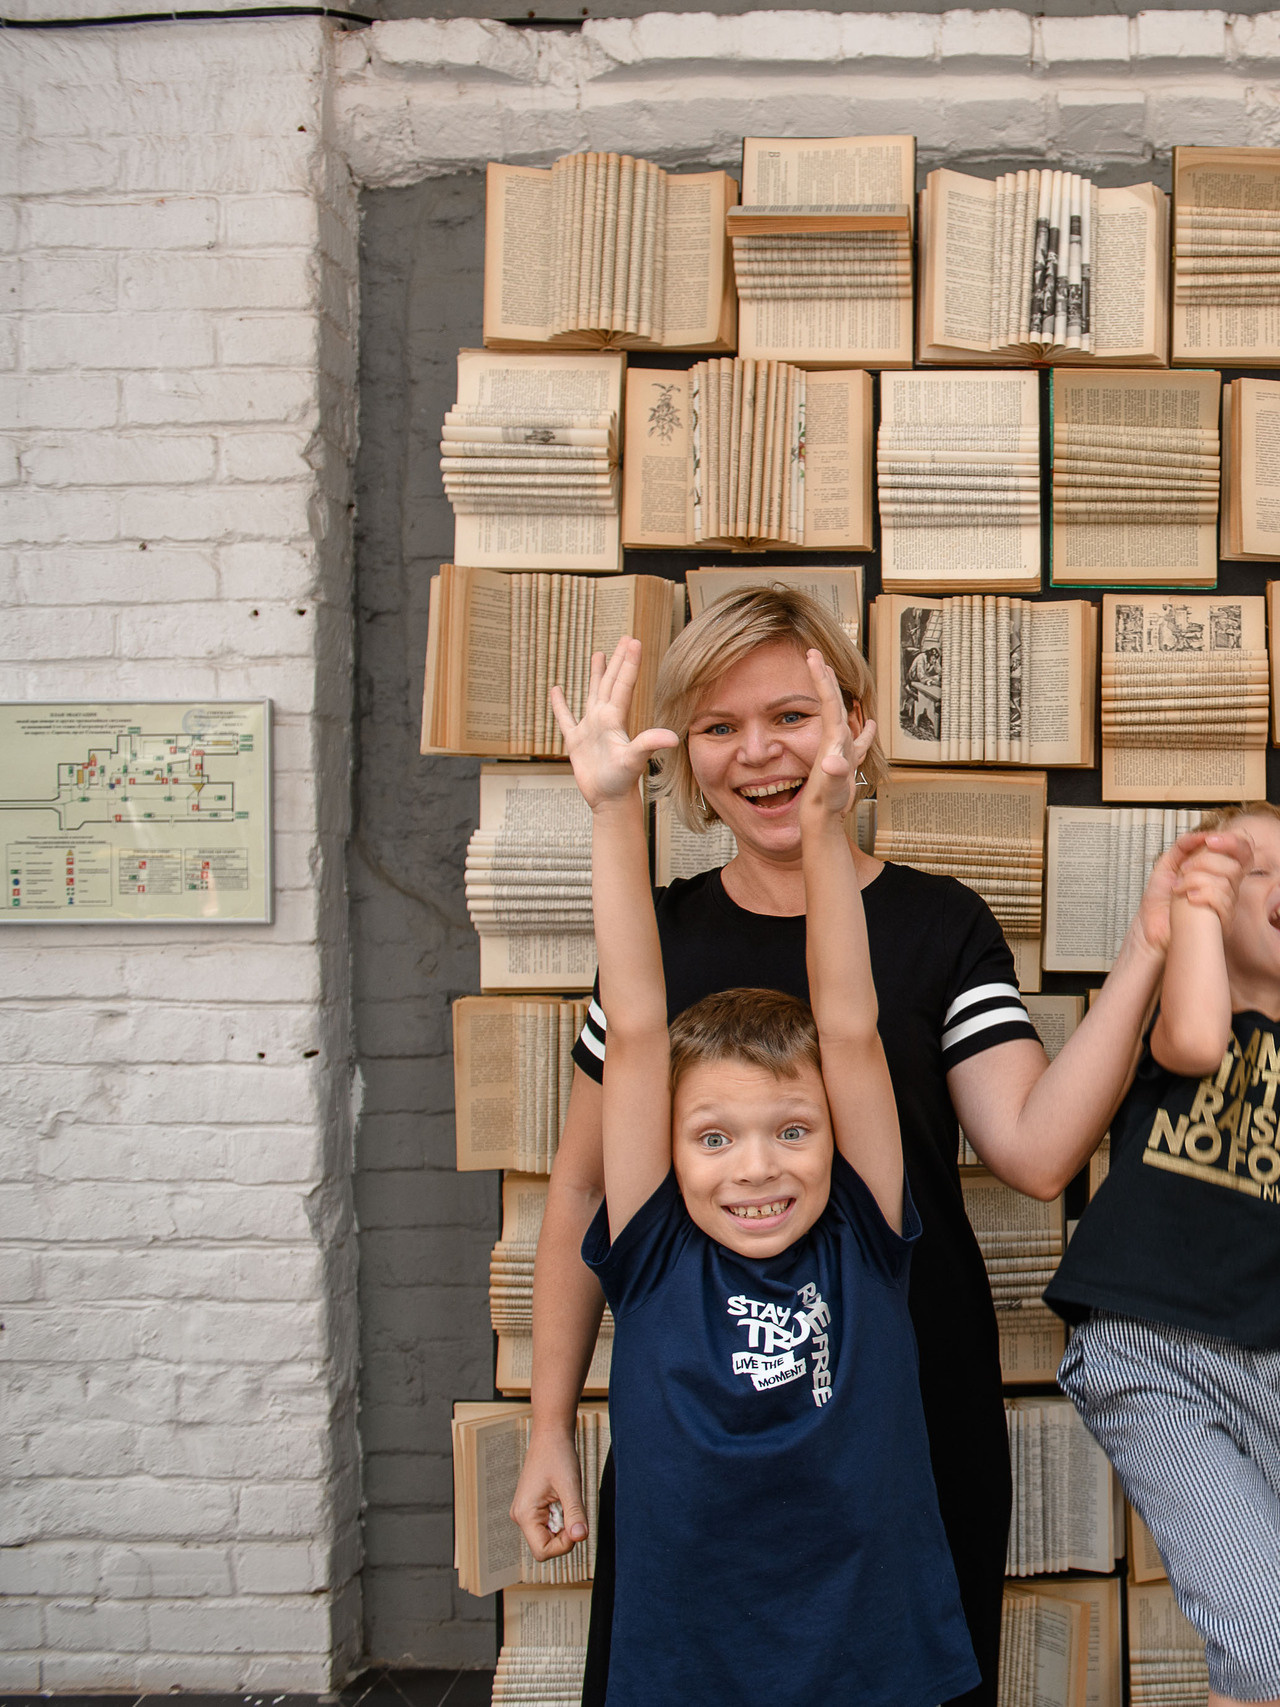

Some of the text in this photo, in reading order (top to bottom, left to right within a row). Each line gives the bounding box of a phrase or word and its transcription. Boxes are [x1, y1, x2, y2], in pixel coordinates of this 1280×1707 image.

[1147, 1108, 1222, 1166] NO
[727, 1295, 791, 1327] STAY
[735, 1356, 785, 1371] LIVE THE
[757, 1364, 804, 1388] MOMENT
[811, 1333, 833, 1408] FREE
